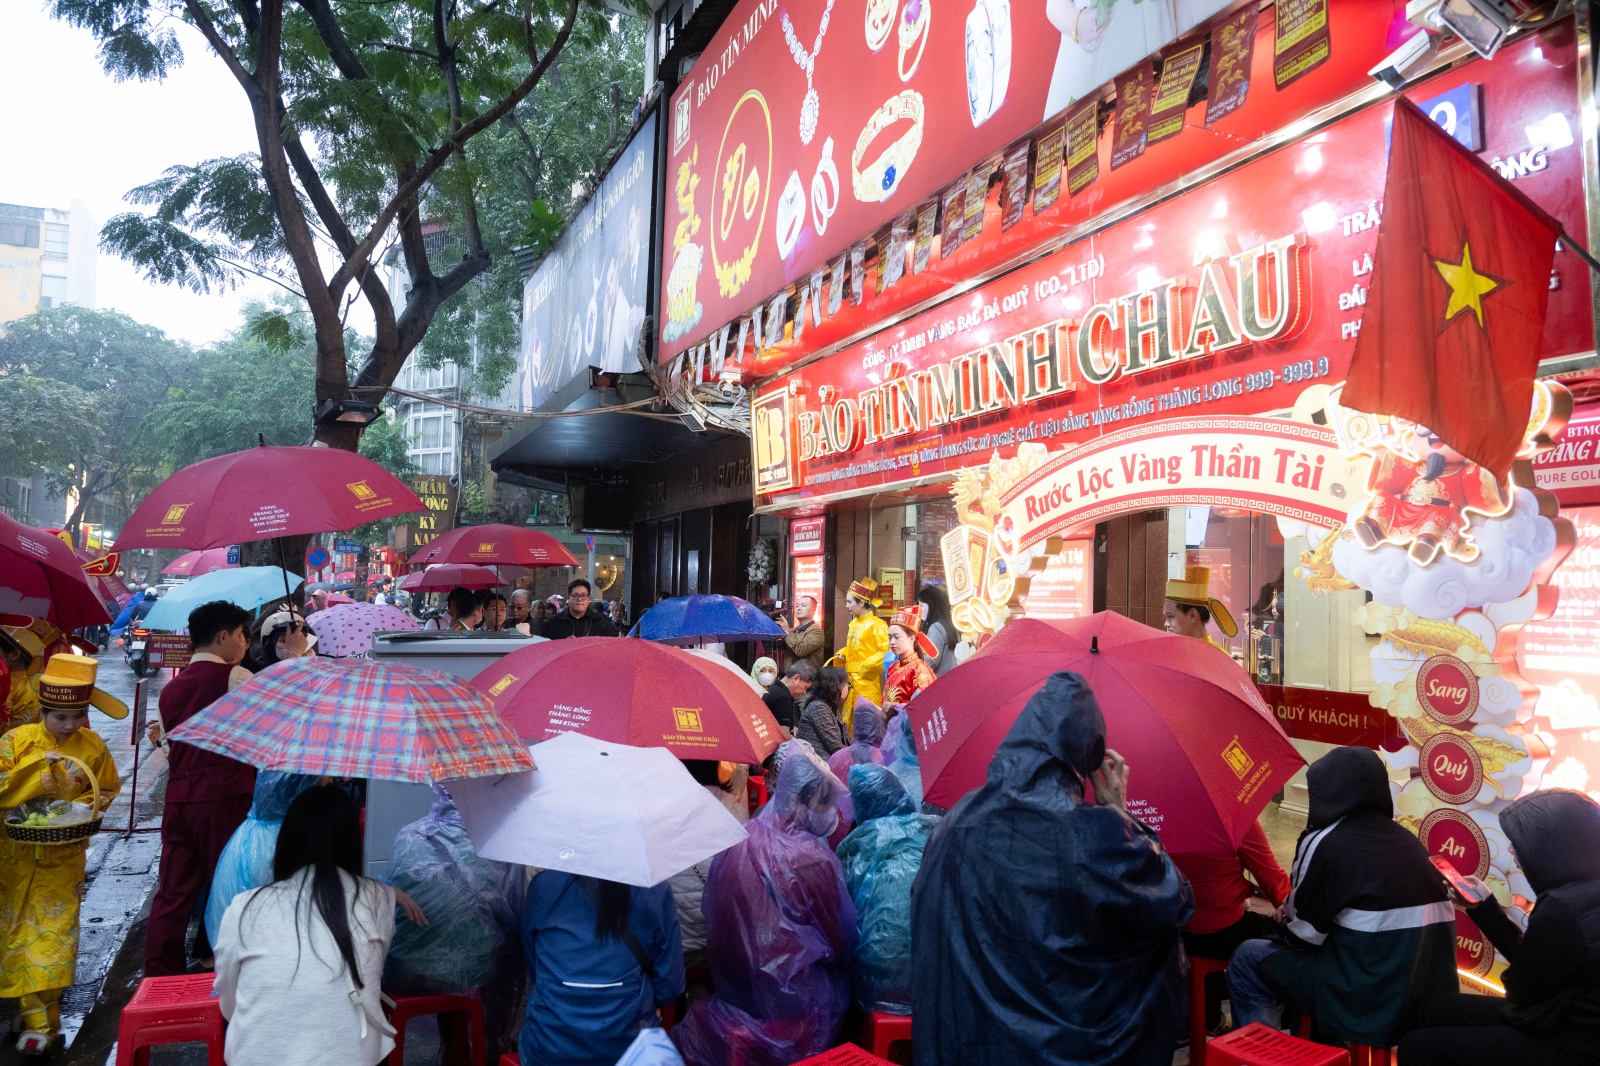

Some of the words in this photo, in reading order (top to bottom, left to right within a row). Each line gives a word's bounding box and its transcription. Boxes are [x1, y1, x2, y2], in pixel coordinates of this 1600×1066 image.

[697, 64, 719, 109] BẢO
[721, 32, 740, 77] TÍN
[608, 182, 625, 210] NAM
[626, 150, 645, 189] GIỚI
[1340, 200, 1384, 237] TRẦ
[1490, 145, 1549, 180] ÔNG
[862, 350, 886, 370] CÔNG
[901, 332, 926, 355] TNHH
[927, 323, 956, 343] VÀNG
[957, 309, 981, 333] BẠC
[983, 297, 1002, 321] ĐÁ
[1002, 285, 1029, 313] QUÝ
[1070, 253, 1105, 287] LTD)
[798, 385, 855, 462] BẢO
[859, 361, 925, 444] TÍN
[930, 320, 1066, 428] MINH
[1078, 234, 1306, 385] CHÂU
[920, 447, 938, 462] VÀNG
[939, 441, 962, 459] TRANG
[962, 436, 977, 454] SỨC
[977, 435, 990, 450] MỸ
[991, 427, 1014, 447] NGHỆ
[1015, 420, 1038, 441] CHẤT
[1039, 417, 1060, 438] LIỆU
[1060, 410, 1089, 433] BẰNG
[1090, 403, 1120, 426] VÀNG
[1121, 391, 1154, 418] RỒNG
[1155, 386, 1200, 412] THĂNG
[1202, 376, 1243, 401] LONG
[1567, 424, 1600, 438] BTMC
[773, 466, 787, 479] 1989
[1536, 472, 1567, 484] PURE
[1571, 469, 1600, 481] GOL
[413, 478, 447, 495] TRÂM
[1024, 481, 1073, 523] Rước
[1077, 467, 1115, 501] Lộc
[1119, 451, 1182, 485] Vàng
[1190, 442, 1262, 481] Thần
[1273, 448, 1325, 491] Tài
[420, 495, 449, 511] ƯƠNG
[259, 514, 276, 522] NGỌC
[266, 518, 287, 526] CƯƠNG
[419, 513, 437, 529] KỲ
[46, 686, 59, 694] BẢO
[1426, 678, 1468, 706] Sang
[549, 710, 571, 718] THĂNG
[572, 714, 591, 722] LONG
[553, 704, 572, 712] VÀNG
[573, 706, 592, 715] RỒNG
[1277, 703, 1306, 724] QUÝ
[1308, 706, 1361, 728] KHÁCH
[703, 735, 720, 743] CHÂU
[1250, 771, 1261, 785] MINH
[1258, 760, 1271, 774] CHÂU
[1433, 754, 1469, 782] Quý
[1126, 799, 1148, 807] VÀNG
[1144, 806, 1158, 815] SỨC
[1148, 814, 1164, 823] QUÝ
[1438, 836, 1466, 858] An
[1456, 935, 1483, 959] ang
